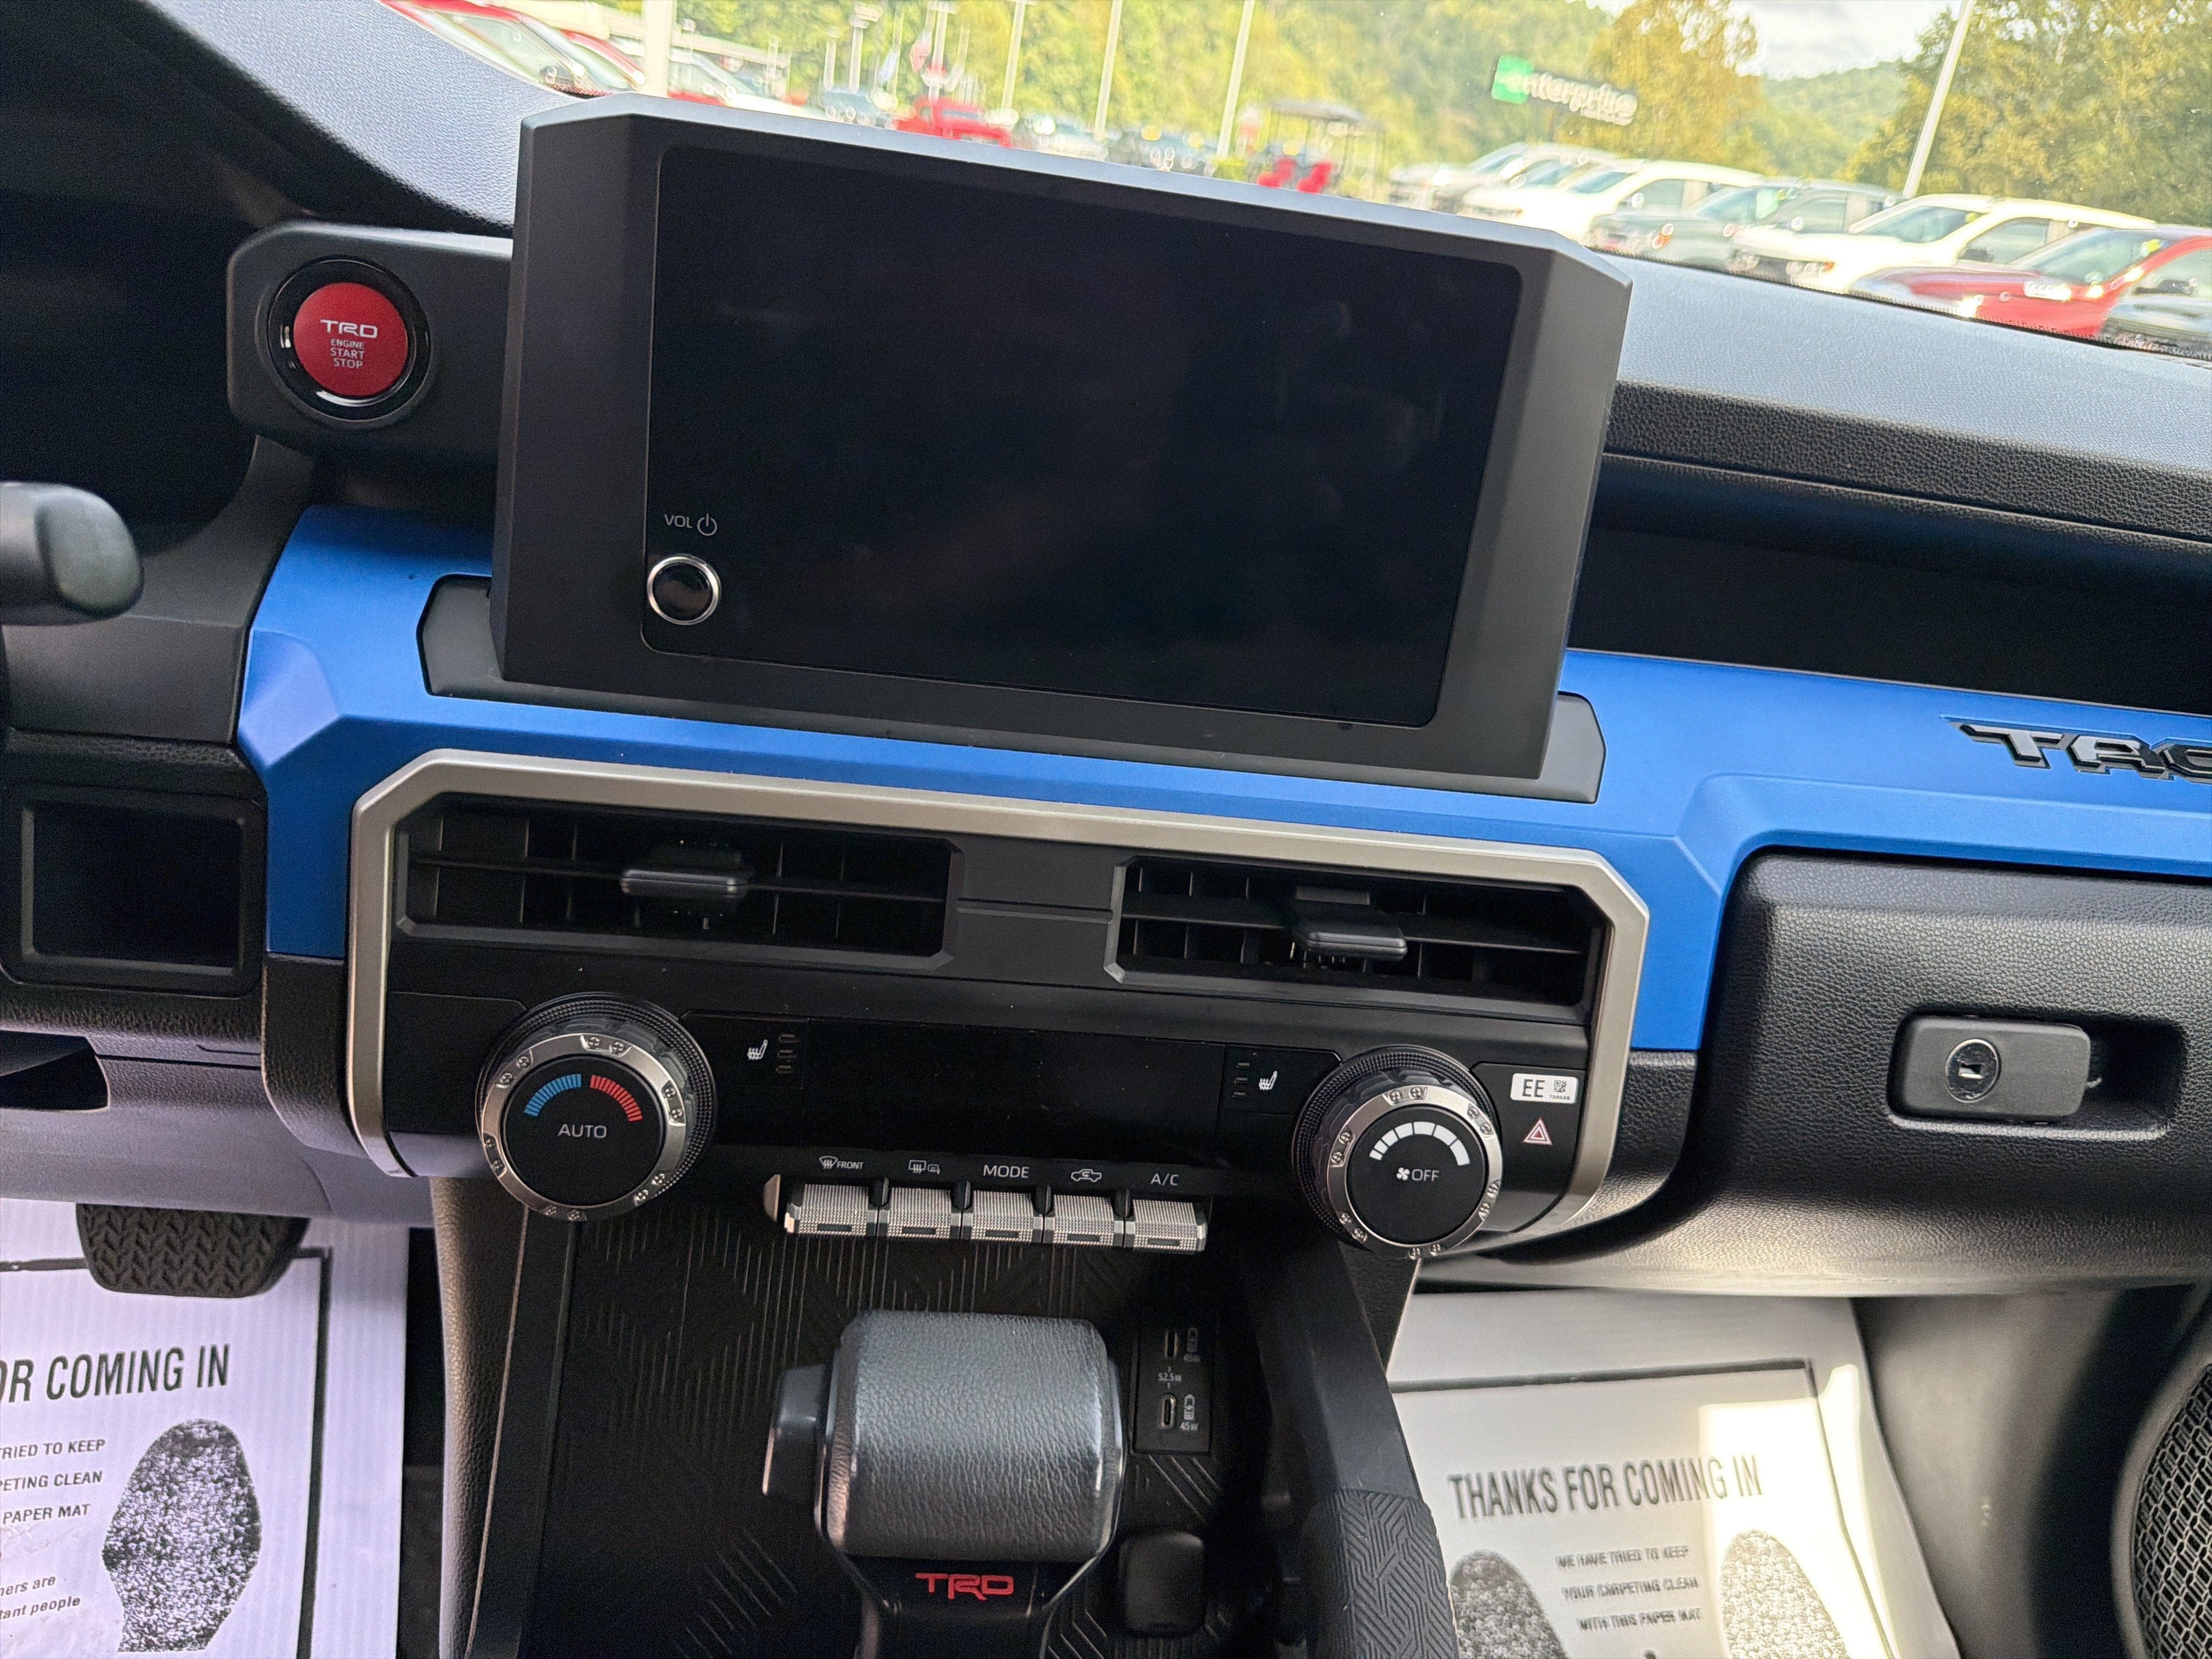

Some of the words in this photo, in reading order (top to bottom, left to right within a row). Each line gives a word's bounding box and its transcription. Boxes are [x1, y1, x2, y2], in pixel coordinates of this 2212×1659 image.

[320, 319, 378, 338] TRD
[331, 338, 365, 349] ENGINE
[330, 347, 365, 359] START
[334, 357, 363, 369] STOP
[664, 514, 693, 528] VOL
[1522, 1079, 1545, 1098] EE
[558, 1123, 607, 1139] AUTO
[837, 1160, 864, 1170] FRONT
[983, 1164, 1030, 1179] MODE
[1150, 1172, 1180, 1187] A/C
[1411, 1168, 1440, 1182] OFF
[46, 1346, 185, 1401] COMING
[196, 1343, 230, 1389] IN
[43, 1442, 63, 1455] TO
[68, 1439, 106, 1453] KEEP
[54, 1470, 103, 1487] CLEAN
[1447, 1466, 1558, 1520] THANKS
[1562, 1463, 1620, 1511] FOR
[1622, 1455, 1728, 1506] COMING
[1732, 1454, 1763, 1497] IN
[3, 1507, 53, 1525] PAPER
[58, 1503, 91, 1518] MAT
[32, 1576, 56, 1590] are
[915, 1572, 1014, 1601] TRD
[30, 1596, 81, 1616] people
